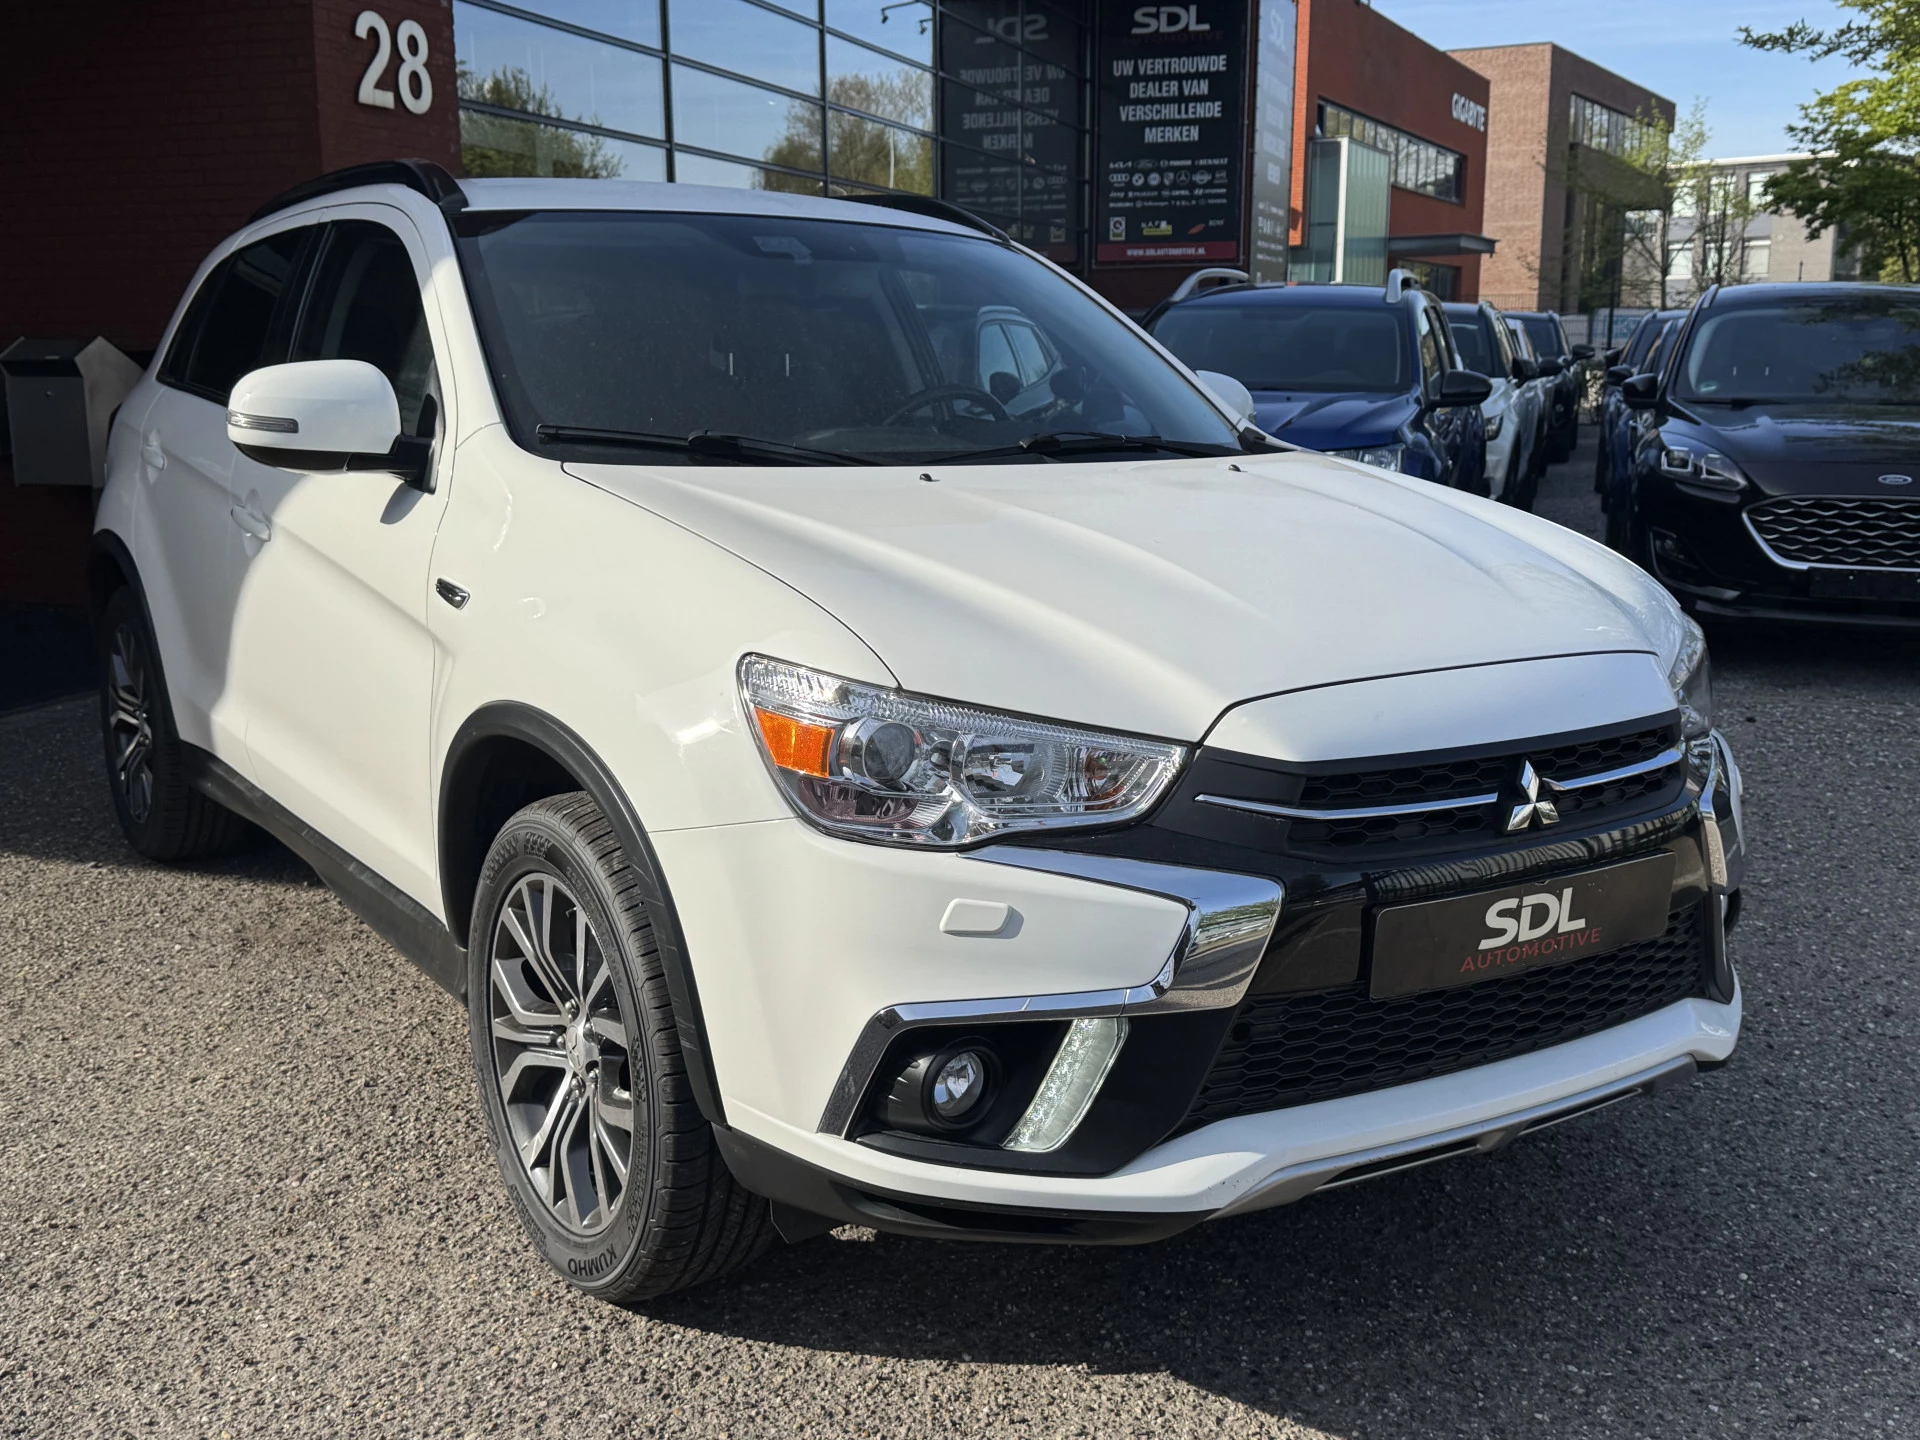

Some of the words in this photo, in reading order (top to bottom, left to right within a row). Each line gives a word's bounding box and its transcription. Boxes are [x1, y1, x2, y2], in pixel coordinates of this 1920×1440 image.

[1131, 4, 1210, 34] SDL
[355, 10, 433, 114] 28
[1113, 60, 1134, 76] UW
[1138, 54, 1227, 75] VERTROUWDE
[1129, 81, 1178, 99] DEALER
[1182, 78, 1208, 97] VAN
[1120, 101, 1222, 122] VERSCHILLENDE
[1144, 125, 1199, 143] MERKEN
[1478, 887, 1586, 950] SDL
[1460, 928, 1601, 973] AUTOMOTIVE
[568, 1243, 618, 1277] KUMHO
